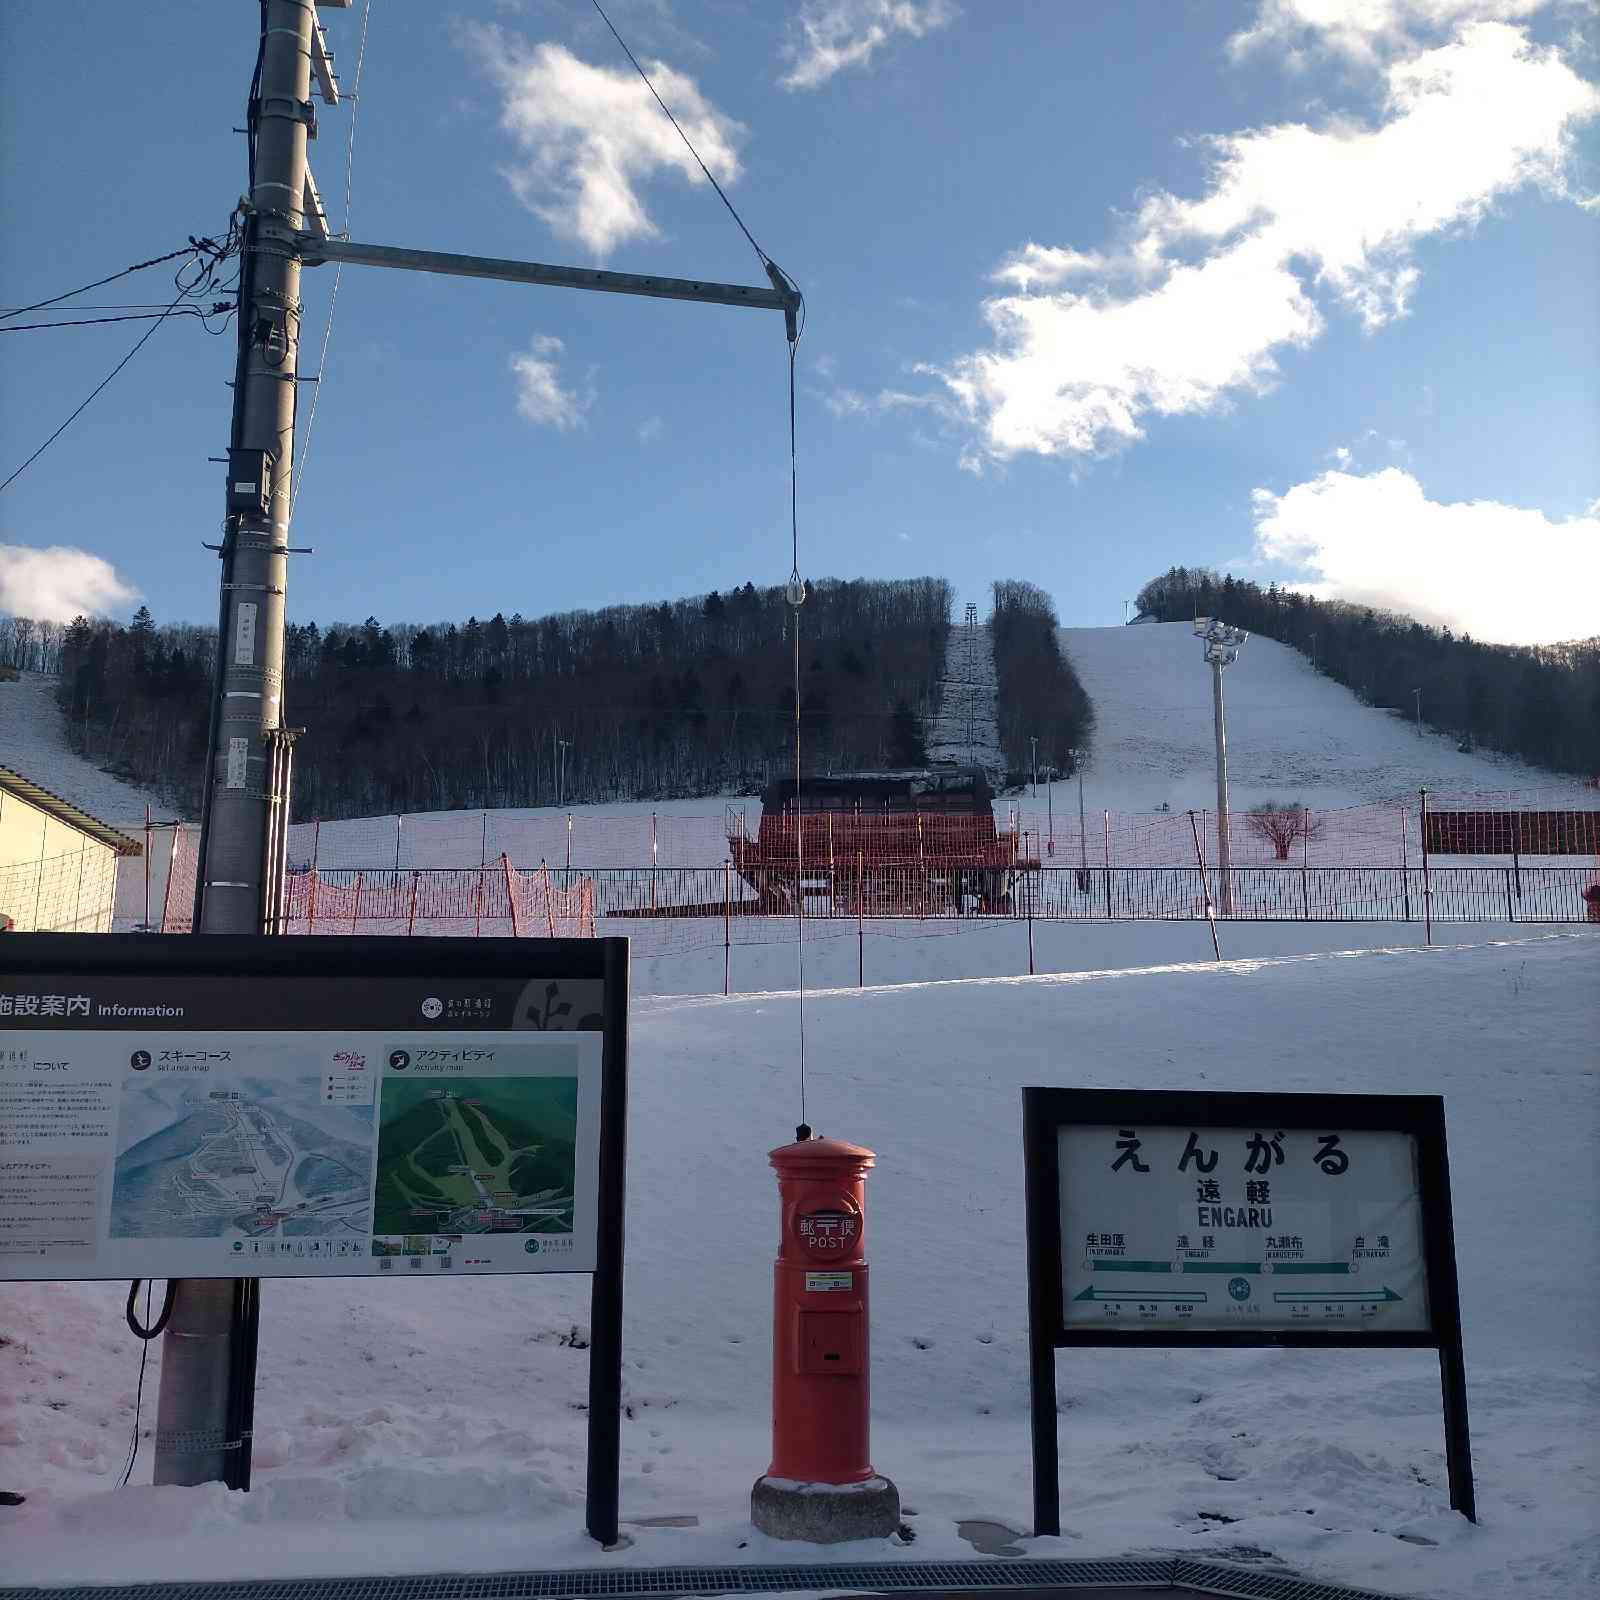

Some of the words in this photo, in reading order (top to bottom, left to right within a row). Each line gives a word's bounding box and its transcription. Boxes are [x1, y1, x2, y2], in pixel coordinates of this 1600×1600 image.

[98, 1003, 184, 1016] Information
[159, 1050, 232, 1062] スキーコース
[416, 1049, 495, 1061] アクティビティ
[414, 1063, 444, 1072] Activity
[1111, 1129, 1350, 1175] えんがる
[1197, 1179, 1271, 1204] 遠軽
[1198, 1206, 1273, 1228] ENGARU
[809, 1236, 846, 1249] POST
[1087, 1233, 1125, 1246] 生田原
